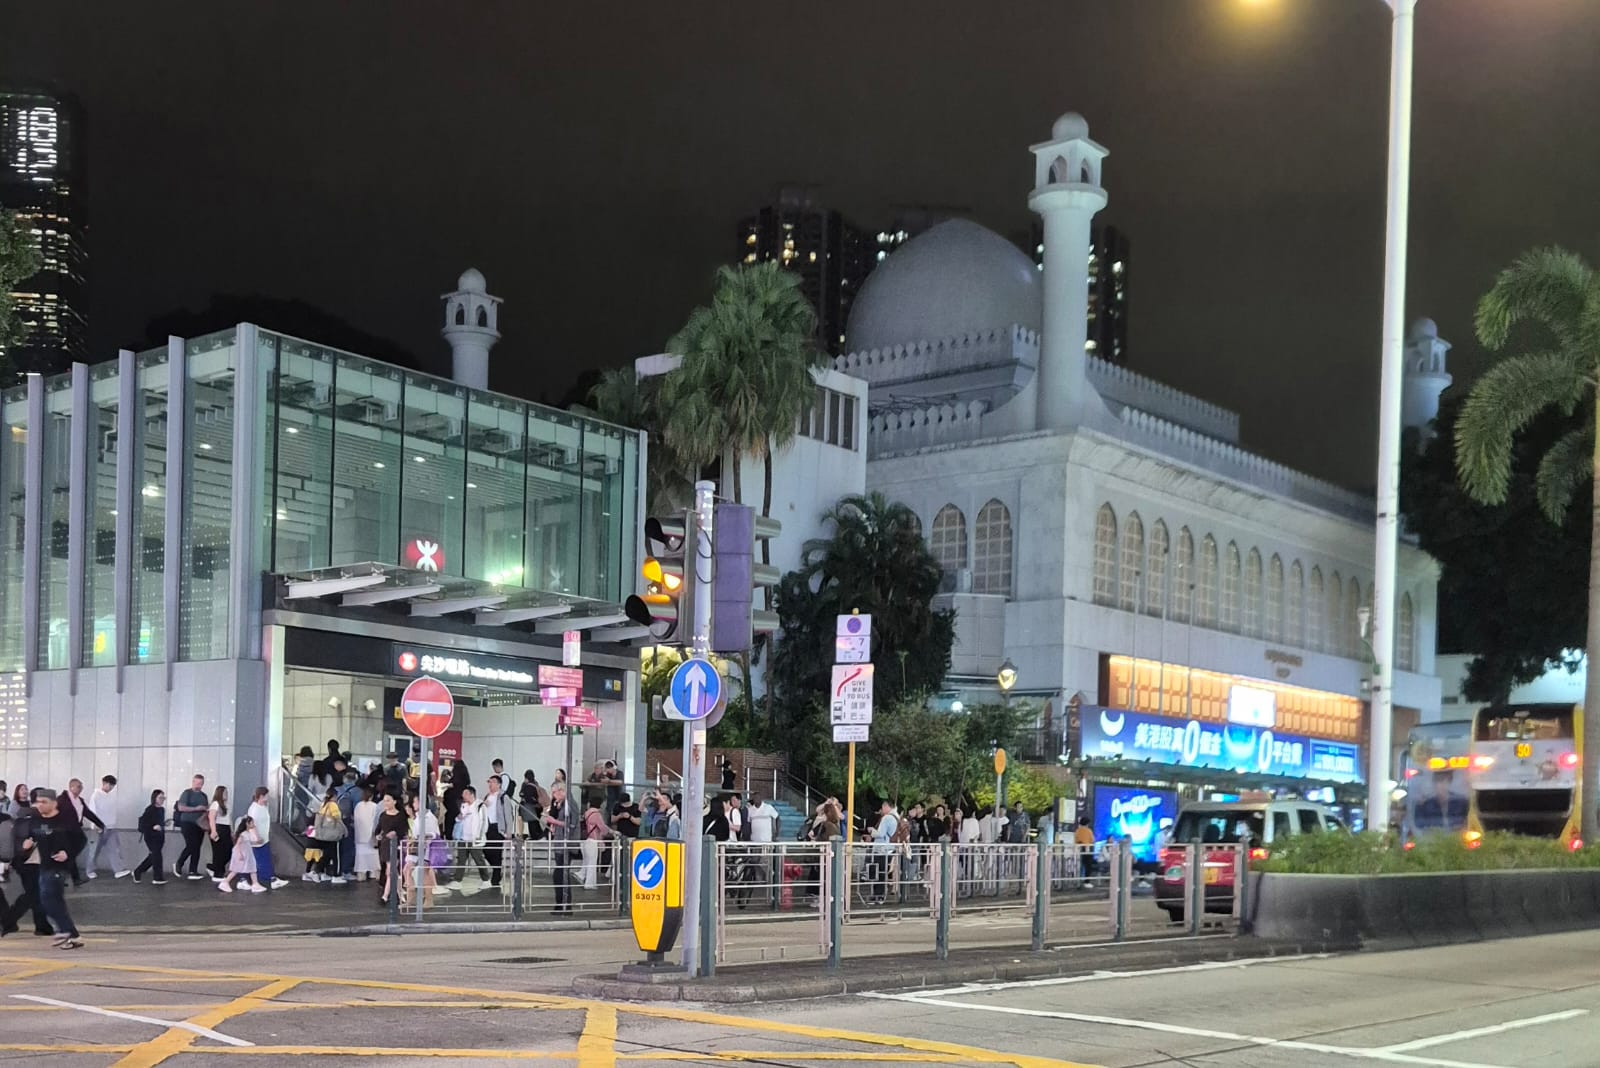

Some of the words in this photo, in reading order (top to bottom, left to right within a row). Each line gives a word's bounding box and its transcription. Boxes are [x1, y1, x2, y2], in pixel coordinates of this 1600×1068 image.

[421, 655, 470, 676] 尖沙站
[635, 892, 661, 901] 63073
